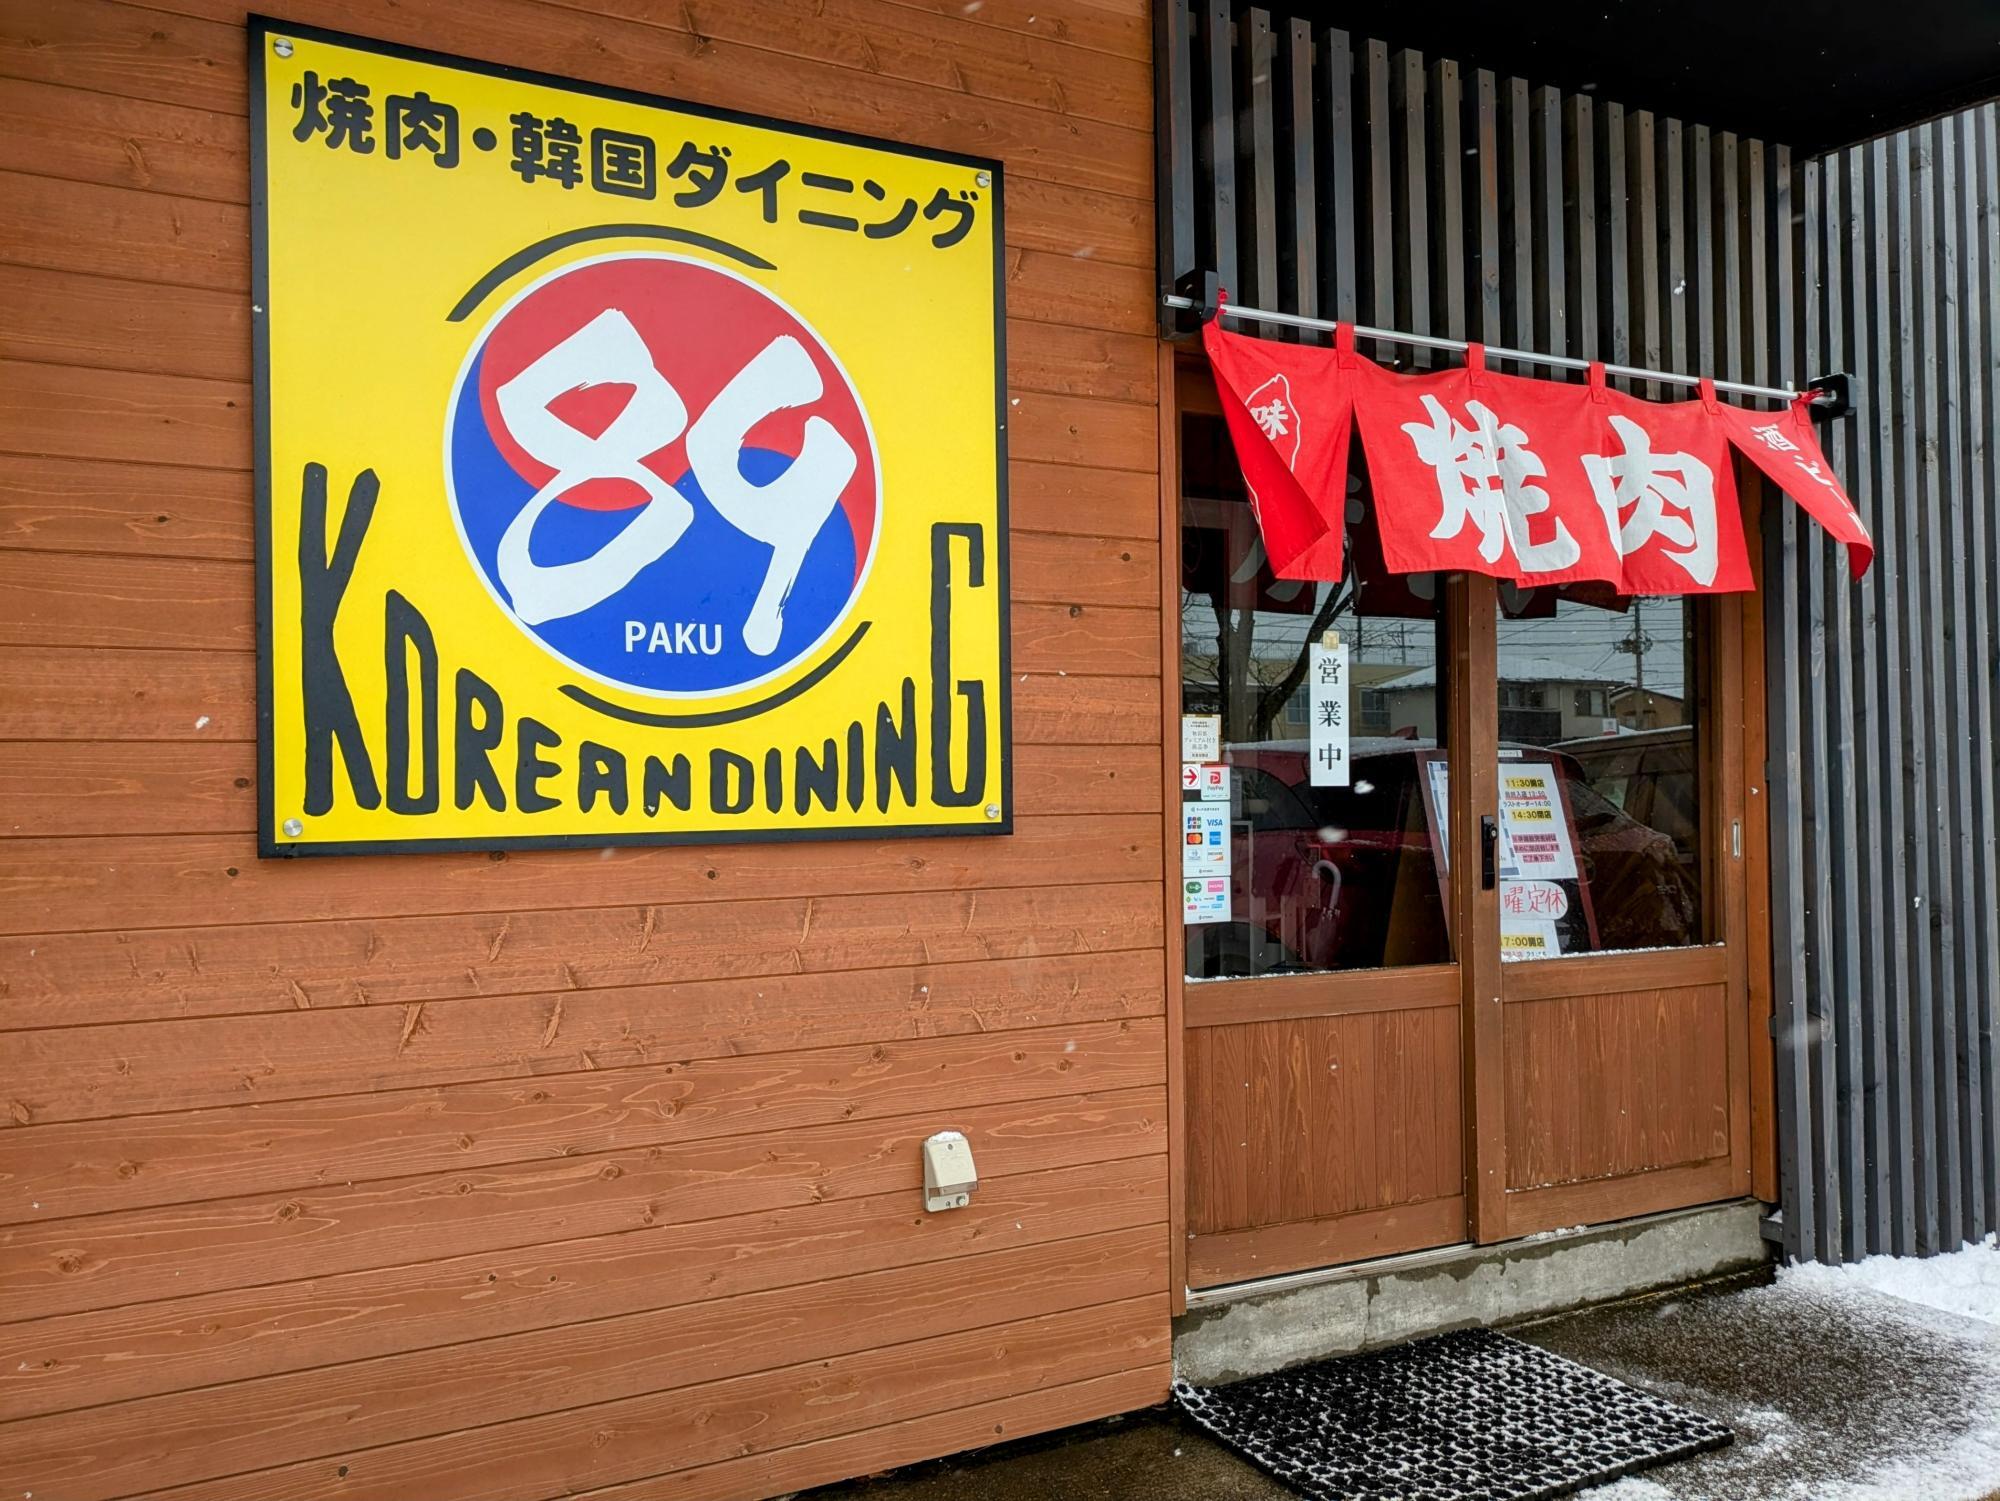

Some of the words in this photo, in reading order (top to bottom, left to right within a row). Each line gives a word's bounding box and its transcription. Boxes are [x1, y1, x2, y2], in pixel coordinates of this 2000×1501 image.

[290, 69, 980, 249] 焼肉・韓国ダイニング
[493, 307, 858, 657] 89
[1400, 393, 1720, 588] 焼肉
[625, 620, 723, 655] PAKU
[1318, 657, 1342, 770] 営業中
[1207, 818, 1223, 826] VISA
[1503, 884, 1566, 914] 曜定休
